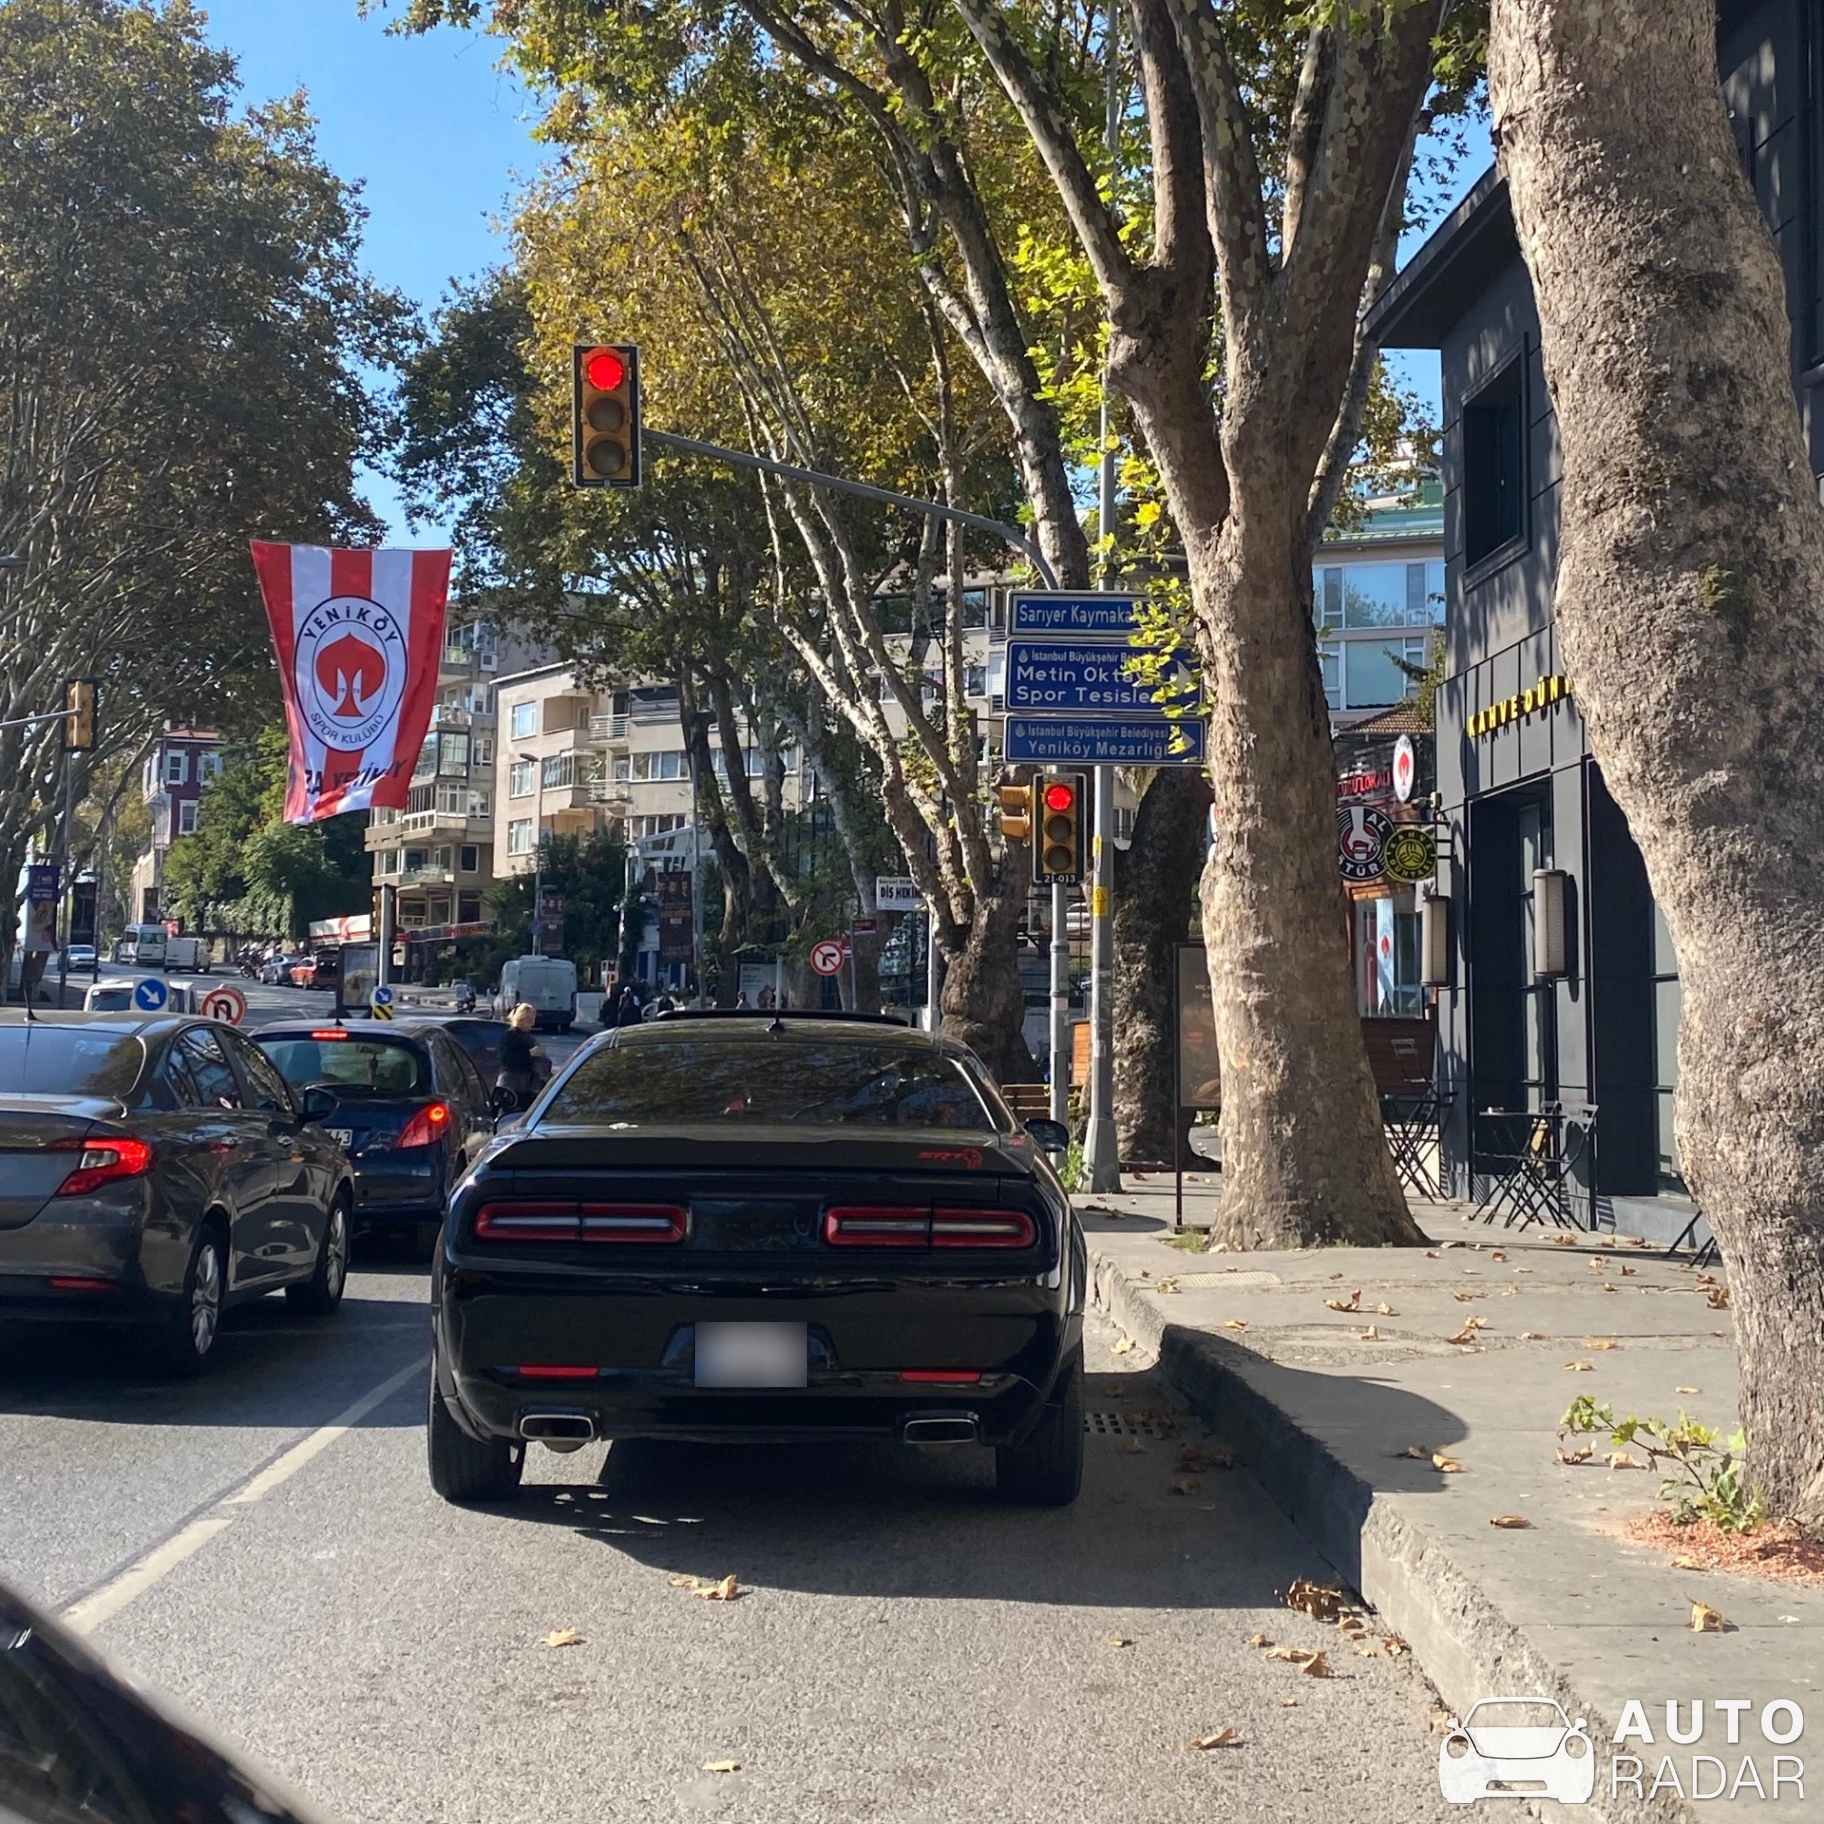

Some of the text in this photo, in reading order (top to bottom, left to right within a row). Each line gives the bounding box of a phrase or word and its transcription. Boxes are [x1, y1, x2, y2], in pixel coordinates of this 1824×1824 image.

[303, 605, 398, 642] YENİKÖY
[1020, 604, 1142, 628] Sarıyer Kaymaka
[1032, 648, 1067, 662] İstanbul
[1069, 651, 1119, 664] Büyükşehir
[1017, 665, 1076, 683] Metin
[1016, 685, 1164, 705] Spor Tesisle
[1467, 694, 1518, 738] KAHVE
[310, 711, 339, 741] SPOR
[1028, 724, 1169, 740] İstanbul Büyükşehir Belediyesi
[1028, 740, 1091, 758] Yeniköy
[1366, 812, 1387, 832] AL
[1390, 831, 1433, 850] KAHVE
[1044, 874, 1076, 883] 21-013
